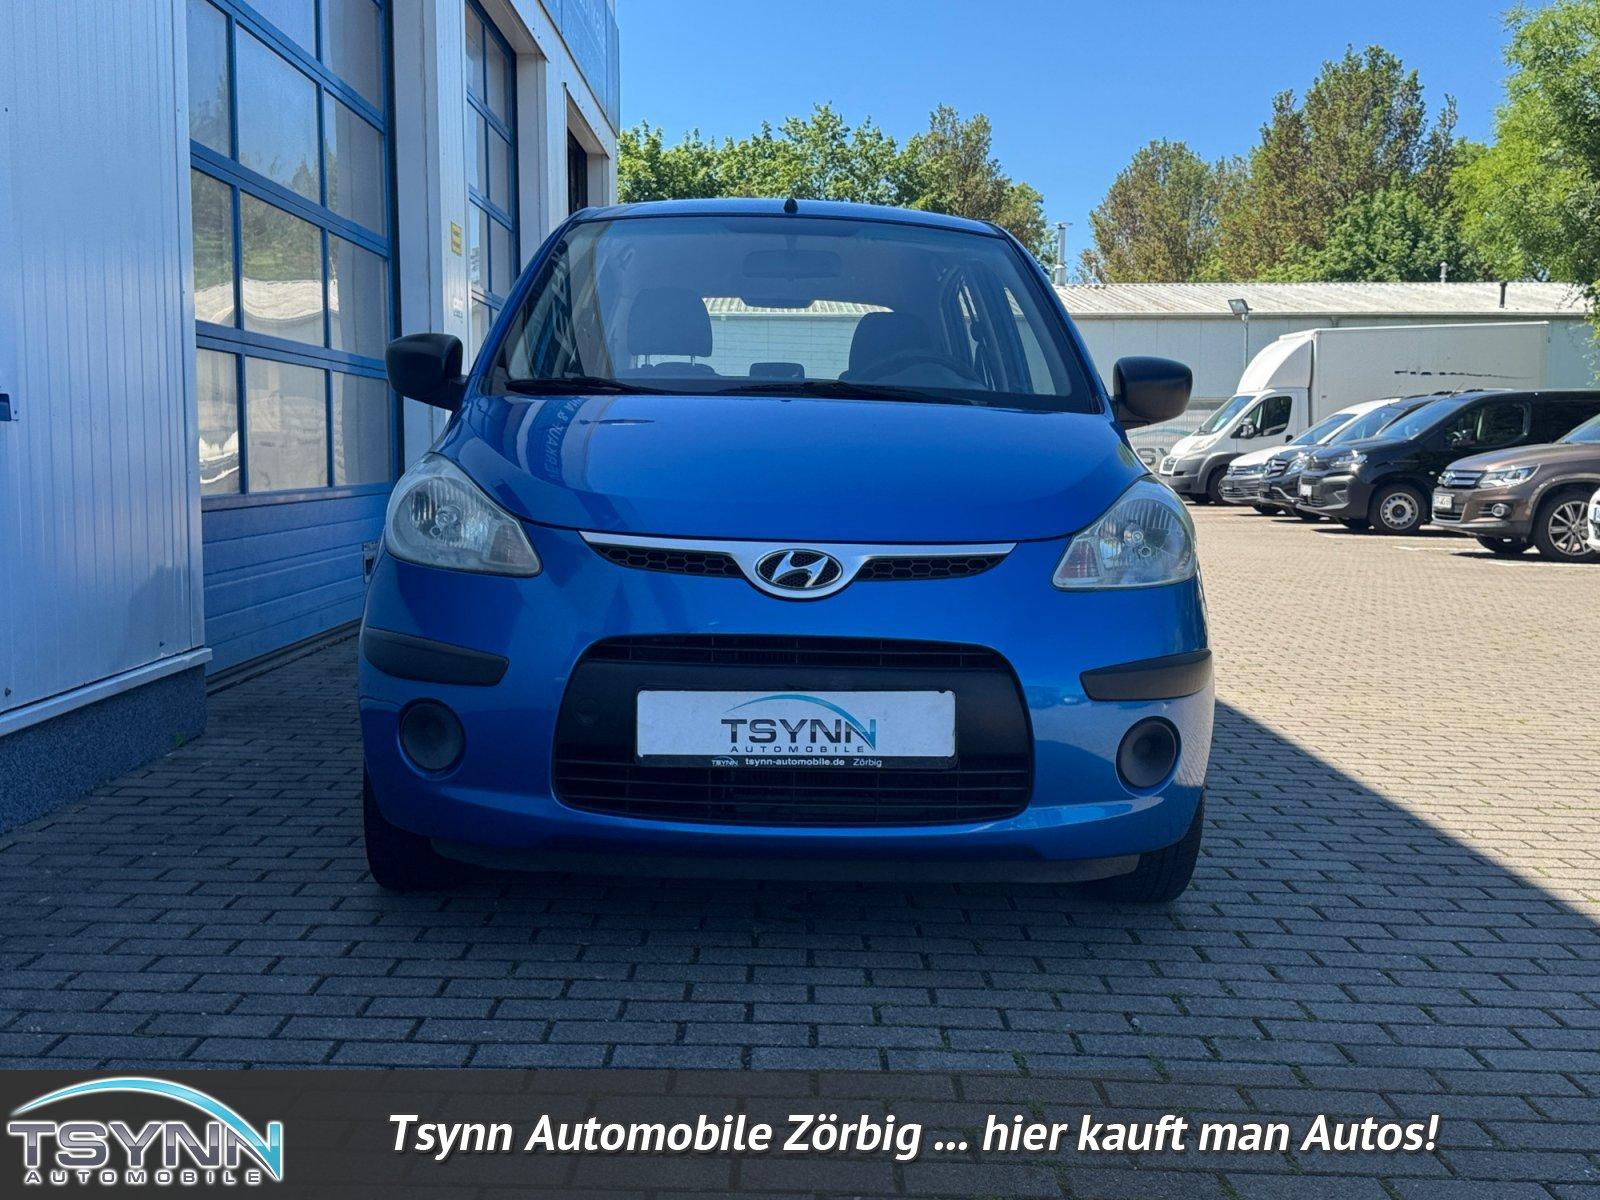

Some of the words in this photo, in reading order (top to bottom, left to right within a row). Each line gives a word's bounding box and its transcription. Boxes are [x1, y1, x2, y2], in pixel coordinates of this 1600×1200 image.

[721, 718, 877, 750] TSYNN
[745, 757, 845, 767] tsynn-automobile.de
[853, 757, 882, 768] Zörbig
